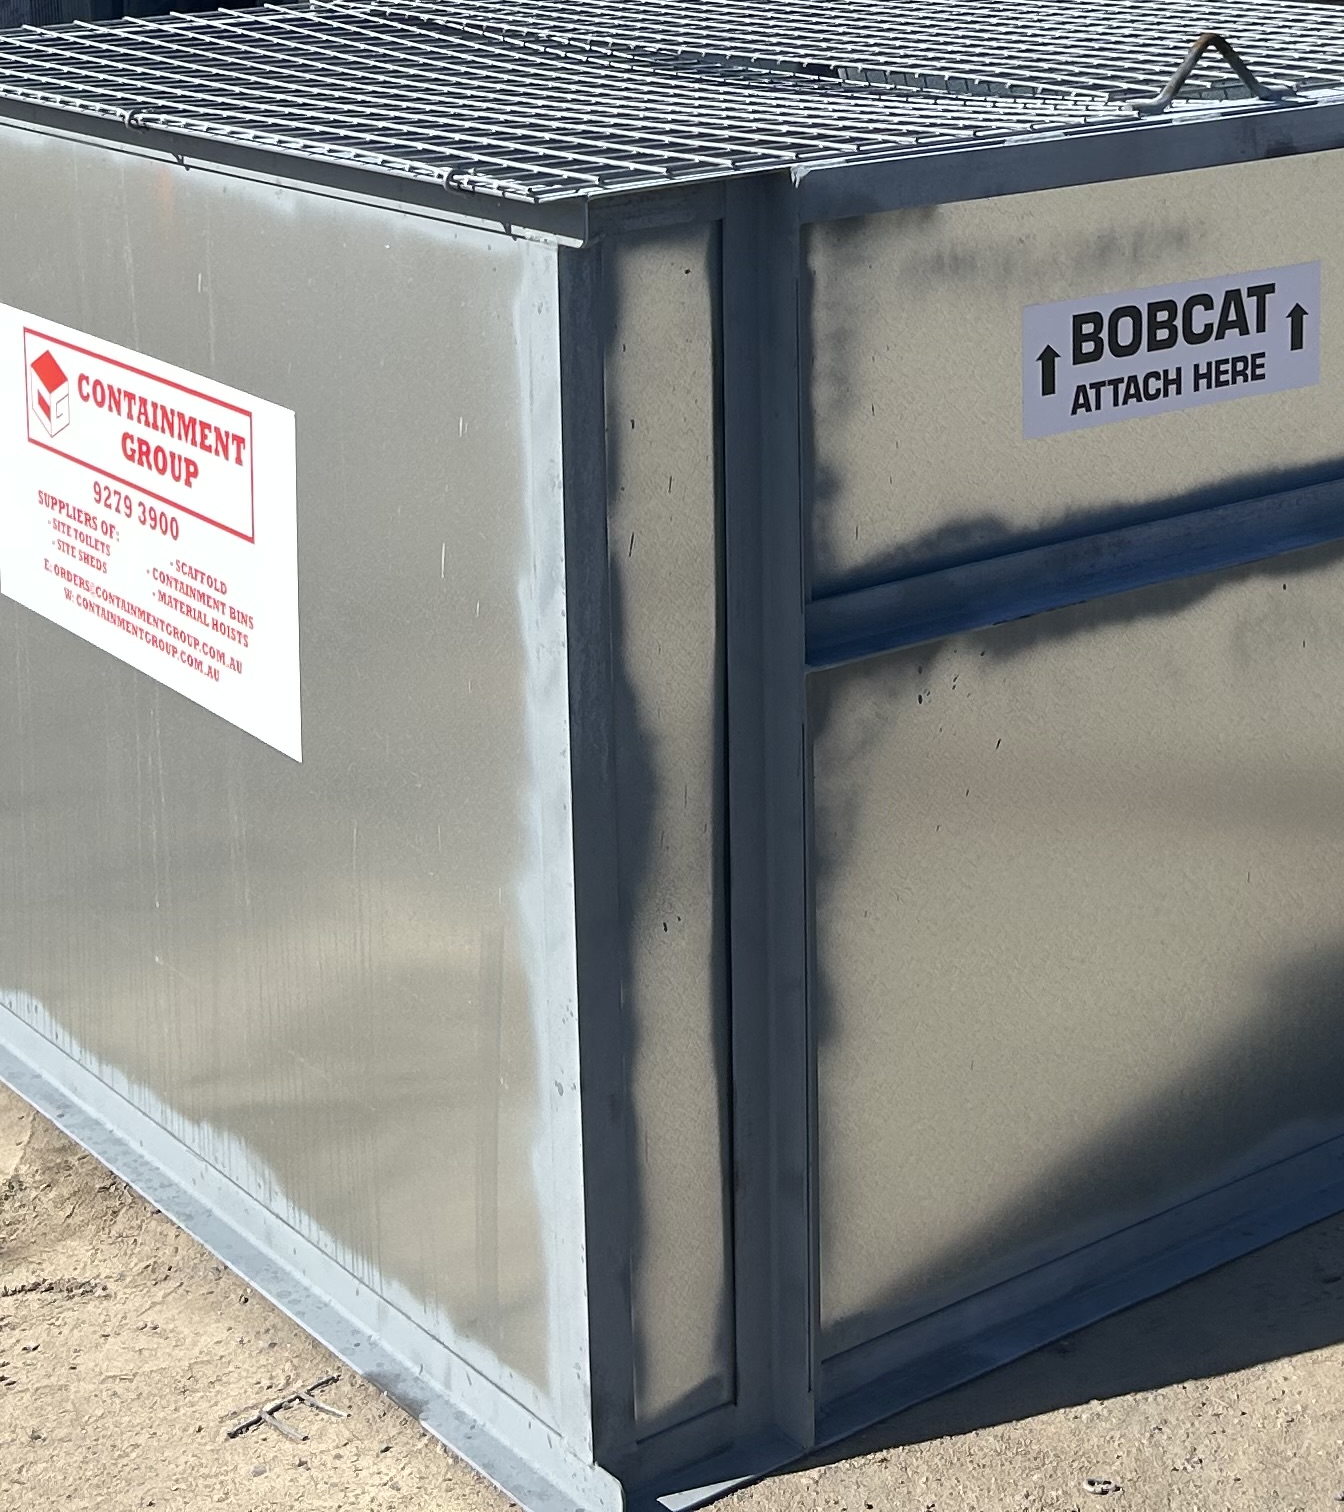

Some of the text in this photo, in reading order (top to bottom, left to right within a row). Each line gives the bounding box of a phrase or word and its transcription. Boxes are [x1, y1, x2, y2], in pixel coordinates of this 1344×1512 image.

[1072, 282, 1276, 366] BOBCAT
[1070, 351, 1266, 416] ATTACH HERE
[77, 373, 245, 466] CONTAINMENT
[121, 431, 200, 488] GROUP
[38, 489, 98, 531] SUPPLIERS
[93, 480, 180, 541] 9279 3900
[73, 526, 111, 557] TOILETS
[78, 549, 107, 574] SHEDS
[211, 617, 249, 648] HOISTS
[229, 605, 254, 630] BINS
